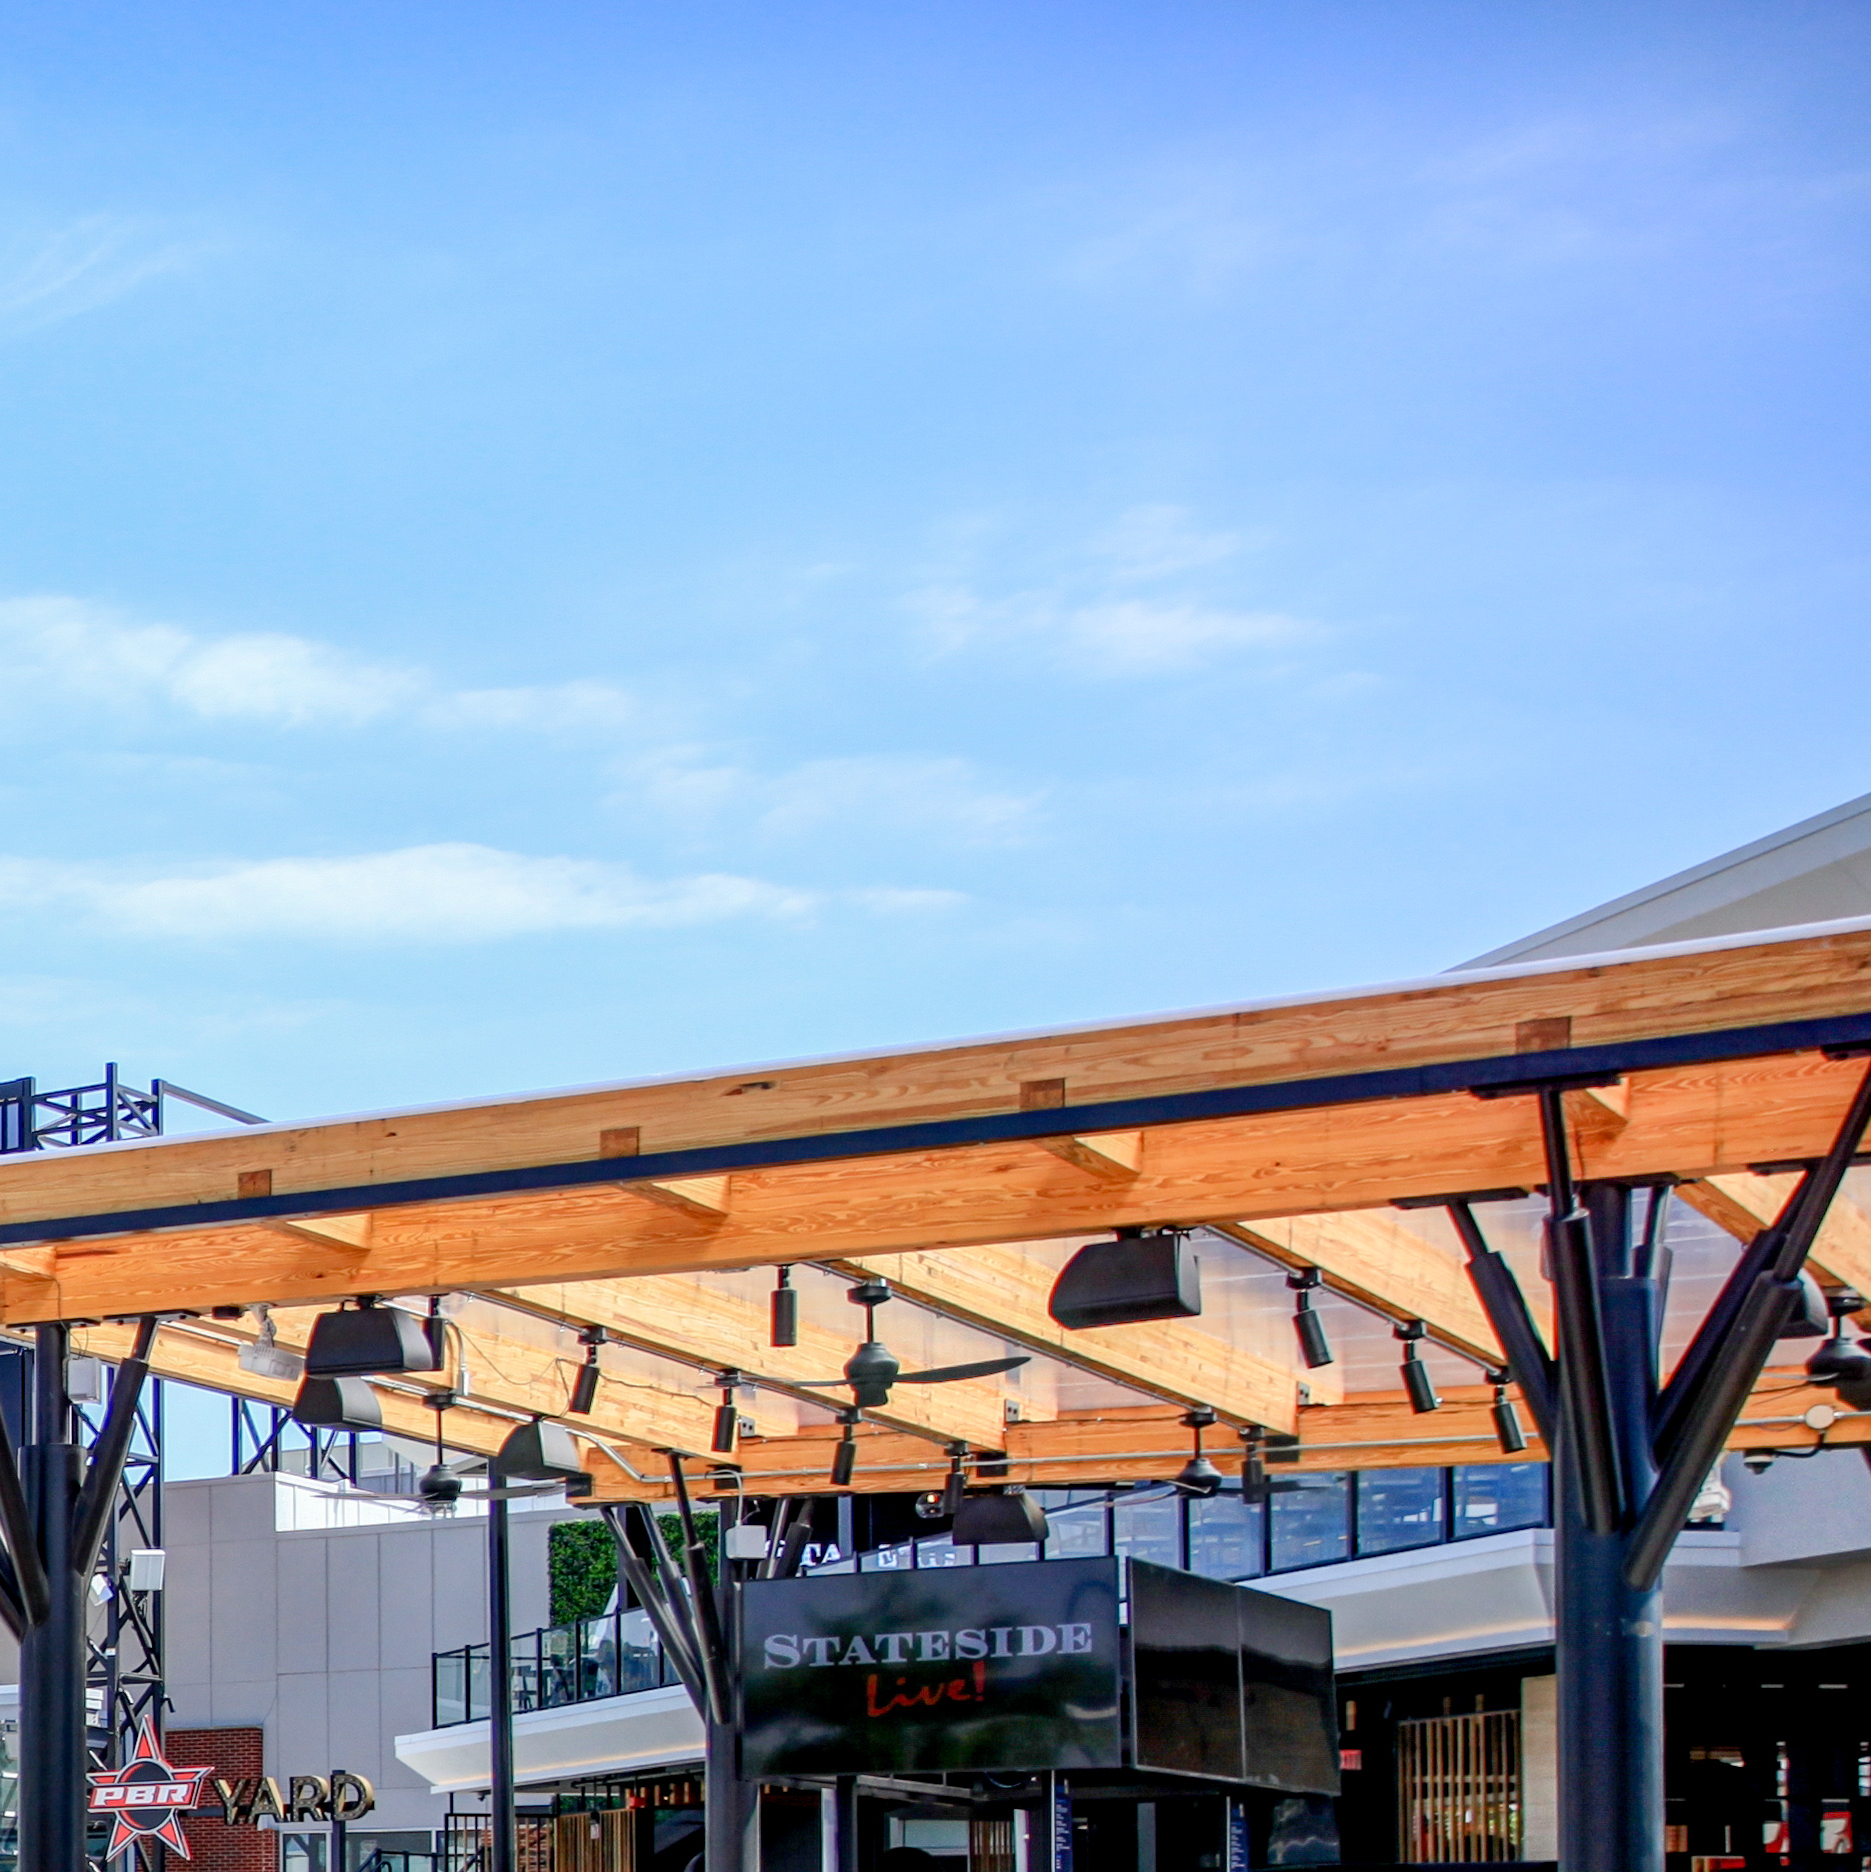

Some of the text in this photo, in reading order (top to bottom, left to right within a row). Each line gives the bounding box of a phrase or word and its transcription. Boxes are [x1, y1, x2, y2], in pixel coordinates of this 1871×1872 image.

[764, 1623, 1093, 1670] STATESIDE
[866, 1660, 986, 1718] Live!
[93, 1772, 375, 1826] PBR YARD
